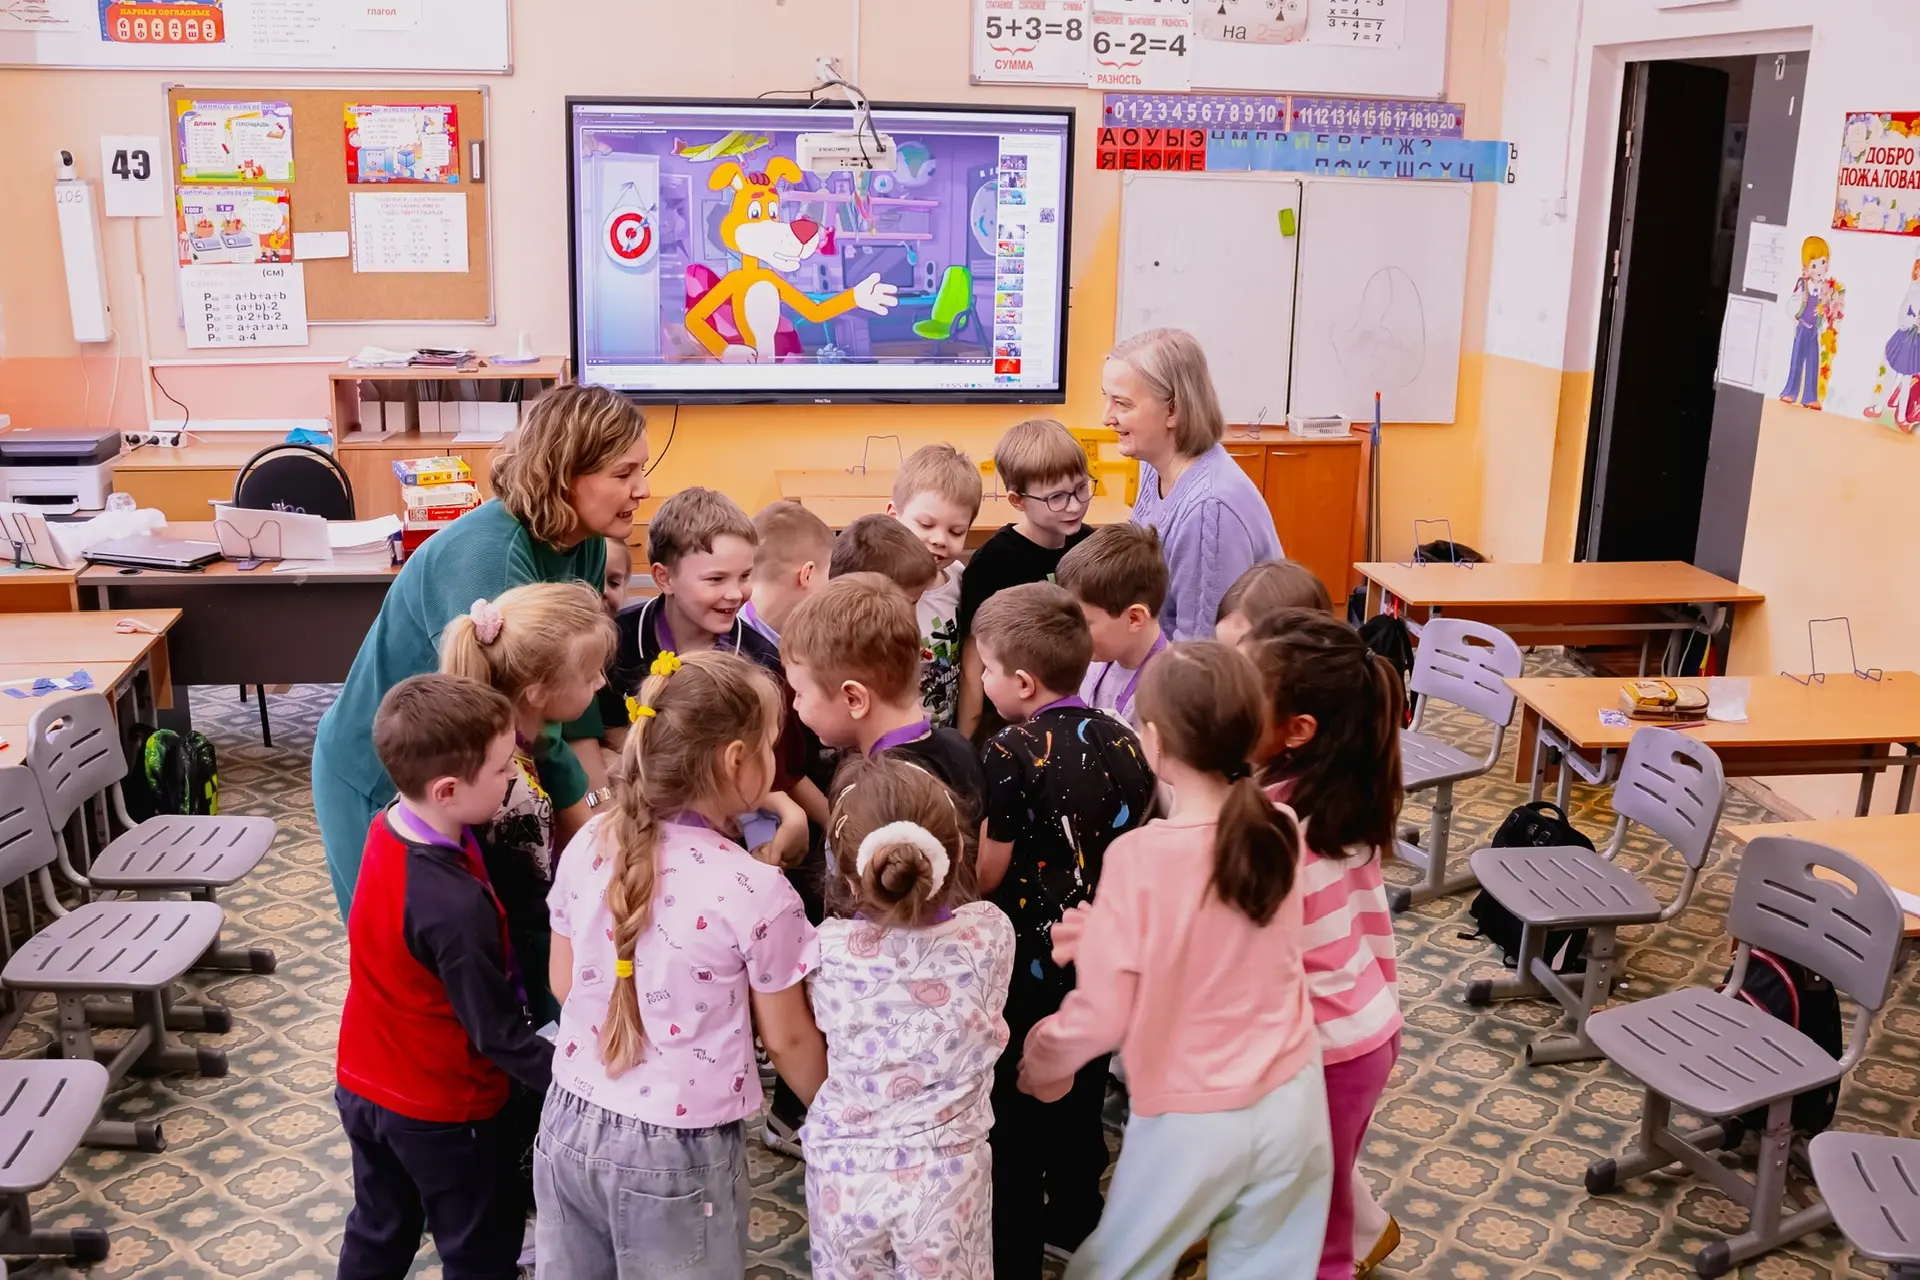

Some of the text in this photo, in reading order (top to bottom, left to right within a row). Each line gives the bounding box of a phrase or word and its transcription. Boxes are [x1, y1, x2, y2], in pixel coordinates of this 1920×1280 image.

[158, 8, 210, 16] СОГЛАСНЫЕ
[1352, 8, 1359, 16] 4
[120, 20, 126, 29] б
[986, 16, 1083, 41] 5+3=8
[1329, 19, 1335, 27] 3
[1376, 22, 1382, 30] 7
[138, 30, 145, 38] ф
[1224, 25, 1247, 40] на
[1352, 32, 1359, 41] 7
[1375, 34, 1381, 42] 7
[1093, 31, 1187, 57] 6-2=4
[995, 59, 1034, 70] СУММА
[1097, 74, 1141, 85] РАЗНОСТЬ
[1114, 102, 1276, 123] 0 1 2 3 4 5 6 7 8 9 10
[1300, 107, 1455, 129] 11 12 13 14 15 16 17 18 19 20
[1101, 129, 1203, 147] А О У Ы Э
[1398, 138, 1415, 155] Ж
[1102, 153, 1116, 169] Я
[1143, 152, 1162, 169] Ю
[1167, 153, 1181, 170] И
[1190, 154, 1202, 170] Е
[1865, 147, 1914, 165] ДОБРО
[1397, 161, 1413, 177] Ш
[1459, 163, 1473, 182] Ц
[57, 190, 83, 203] 206
